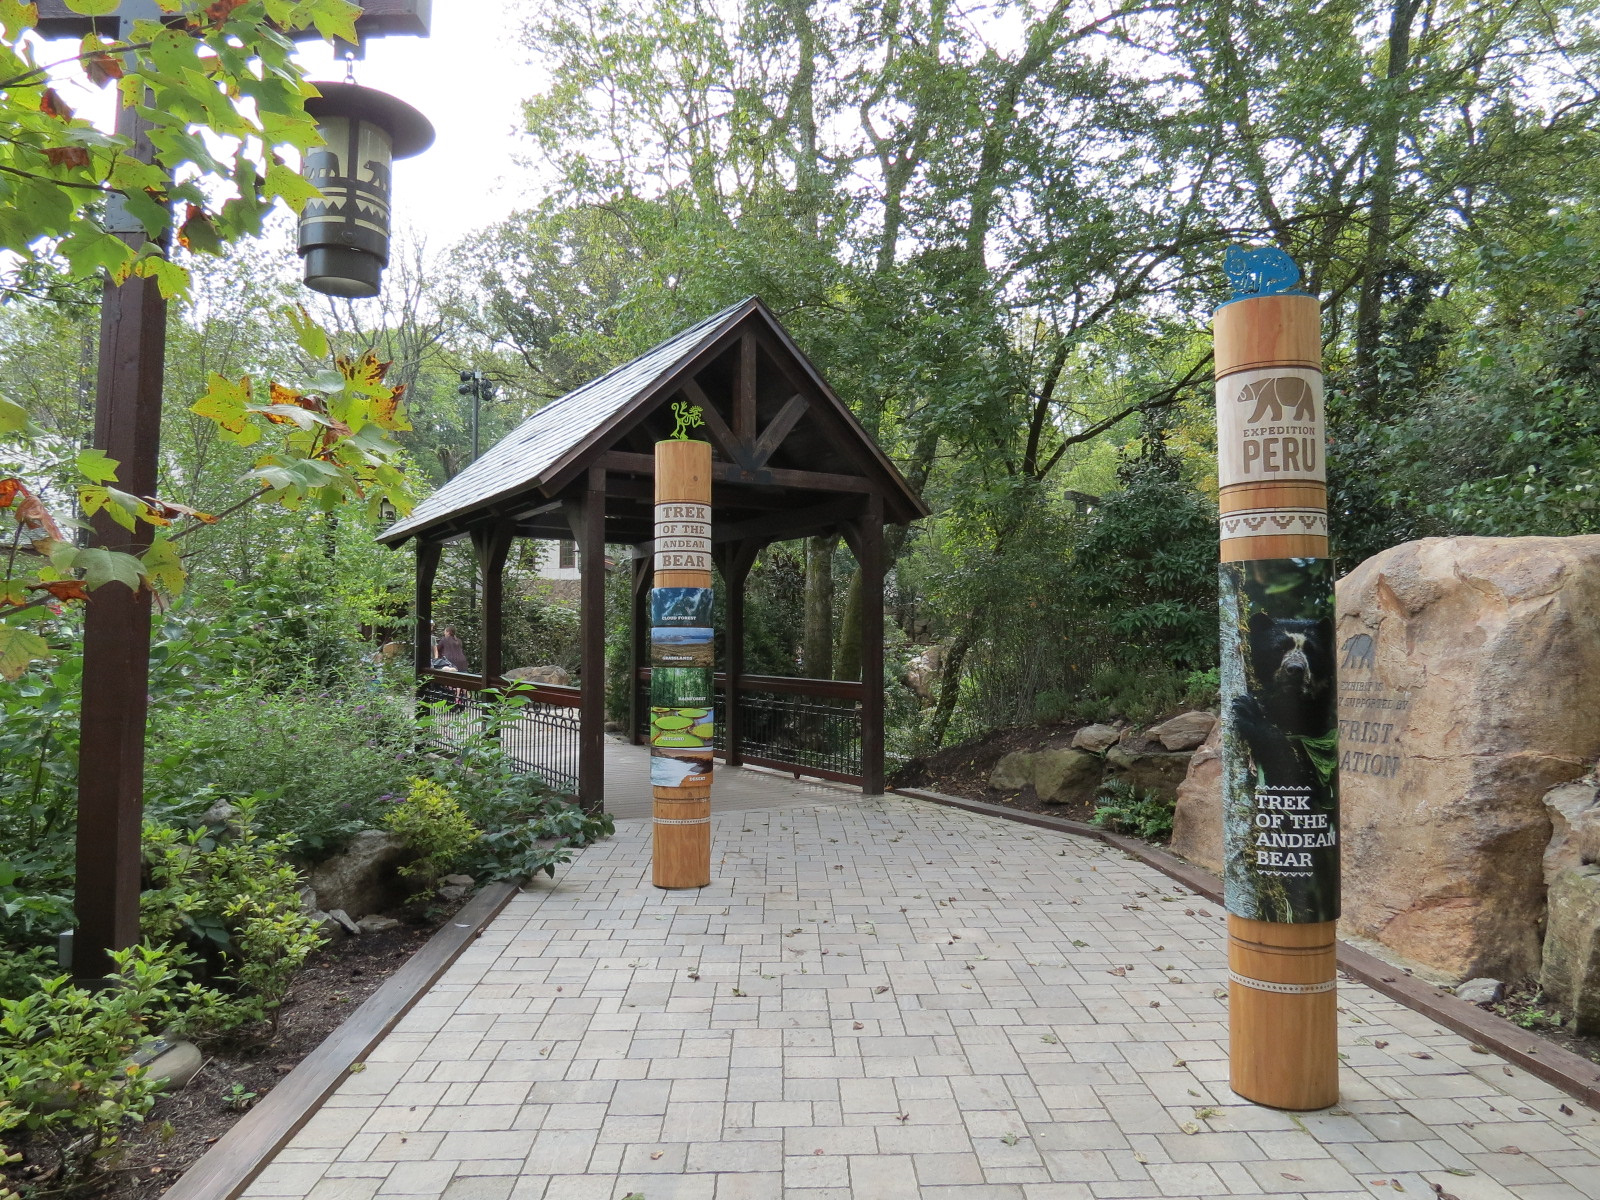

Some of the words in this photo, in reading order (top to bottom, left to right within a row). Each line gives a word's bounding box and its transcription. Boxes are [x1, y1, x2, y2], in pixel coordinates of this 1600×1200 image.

[1243, 426, 1315, 437] EXPEDITION
[1243, 437, 1316, 474] PERU
[663, 506, 705, 519] TREK
[663, 525, 677, 534] OF
[682, 525, 705, 534] THE
[663, 540, 705, 548] ANDEAN
[663, 554, 705, 567] BEAR
[1341, 681, 1373, 692] EXHIBIT
[1255, 794, 1310, 810] TREK
[1255, 813, 1285, 829] OF
[1290, 813, 1328, 829] THE
[1255, 832, 1336, 848] ANDEAN
[1256, 850, 1313, 867] BEAR
